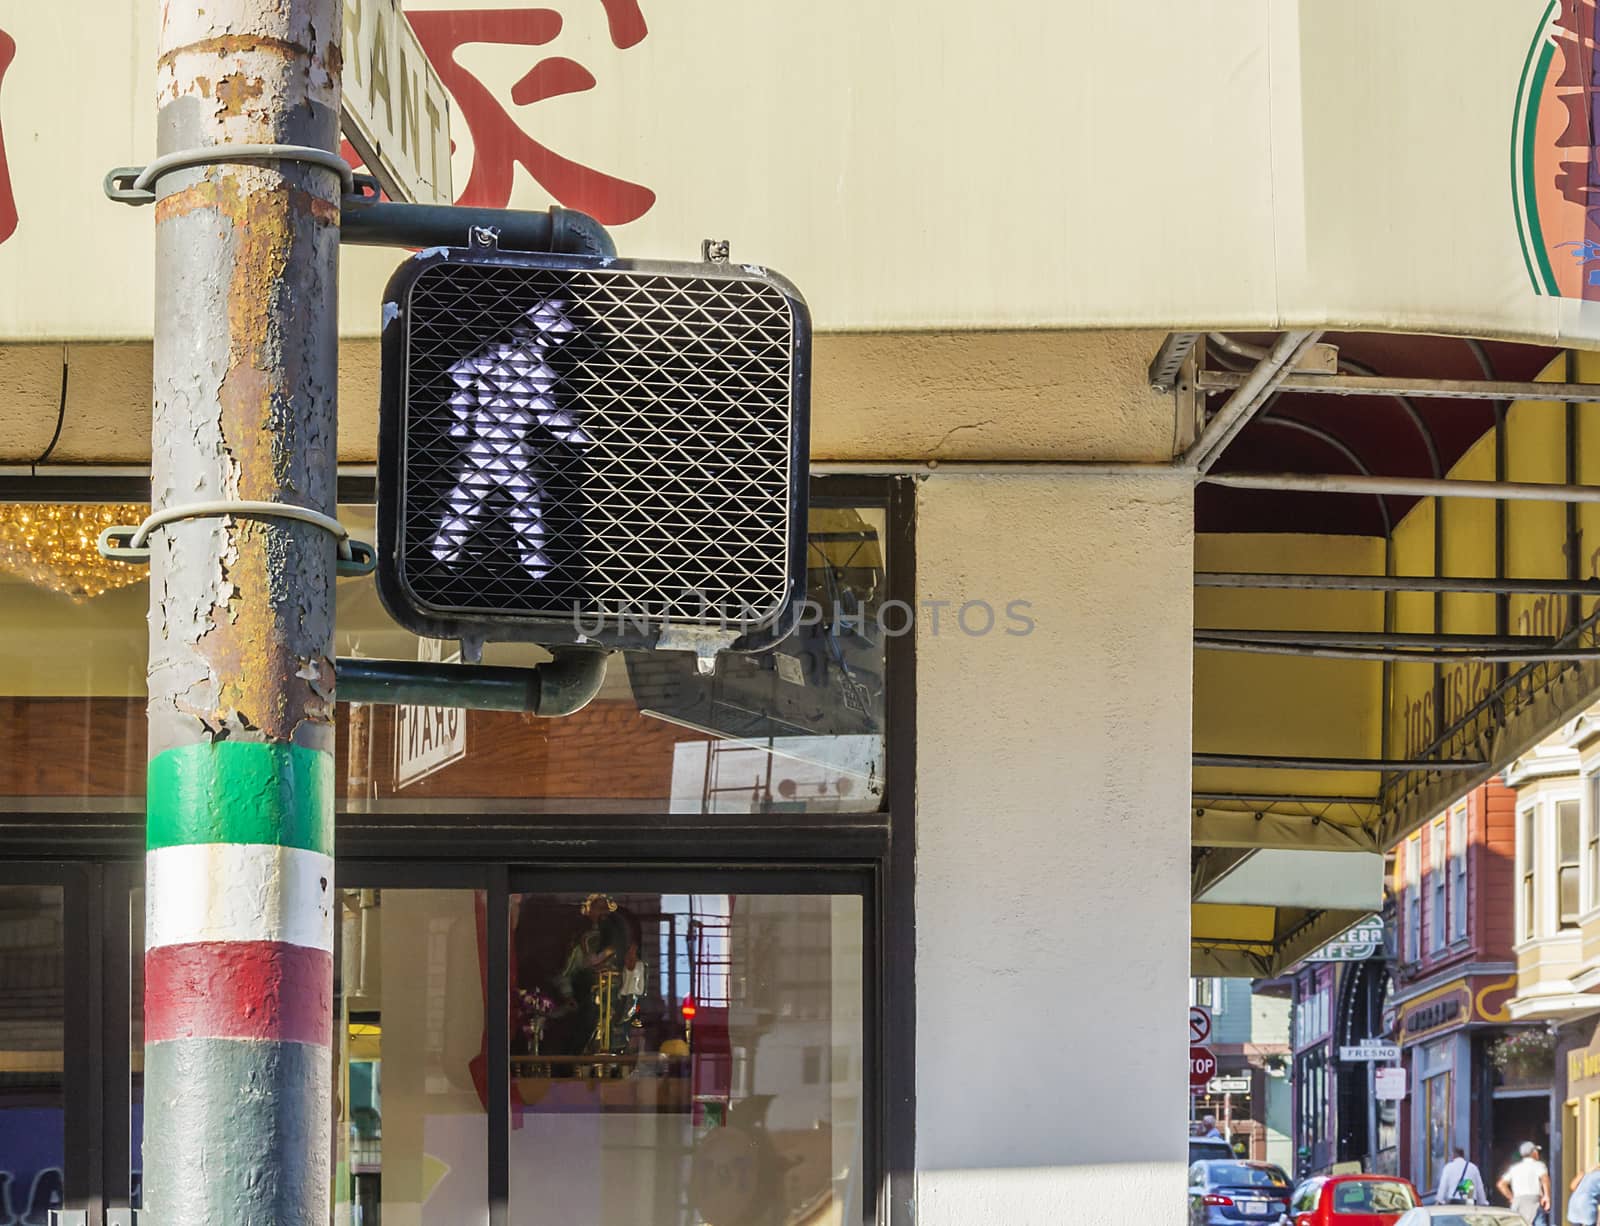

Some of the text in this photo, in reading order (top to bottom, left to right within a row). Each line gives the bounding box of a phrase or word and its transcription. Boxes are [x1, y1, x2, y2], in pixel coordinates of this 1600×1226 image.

[342, 0, 440, 203] RANT
[1348, 1049, 1396, 1057] FRESNO
[1190, 1059, 1213, 1074] TOP
